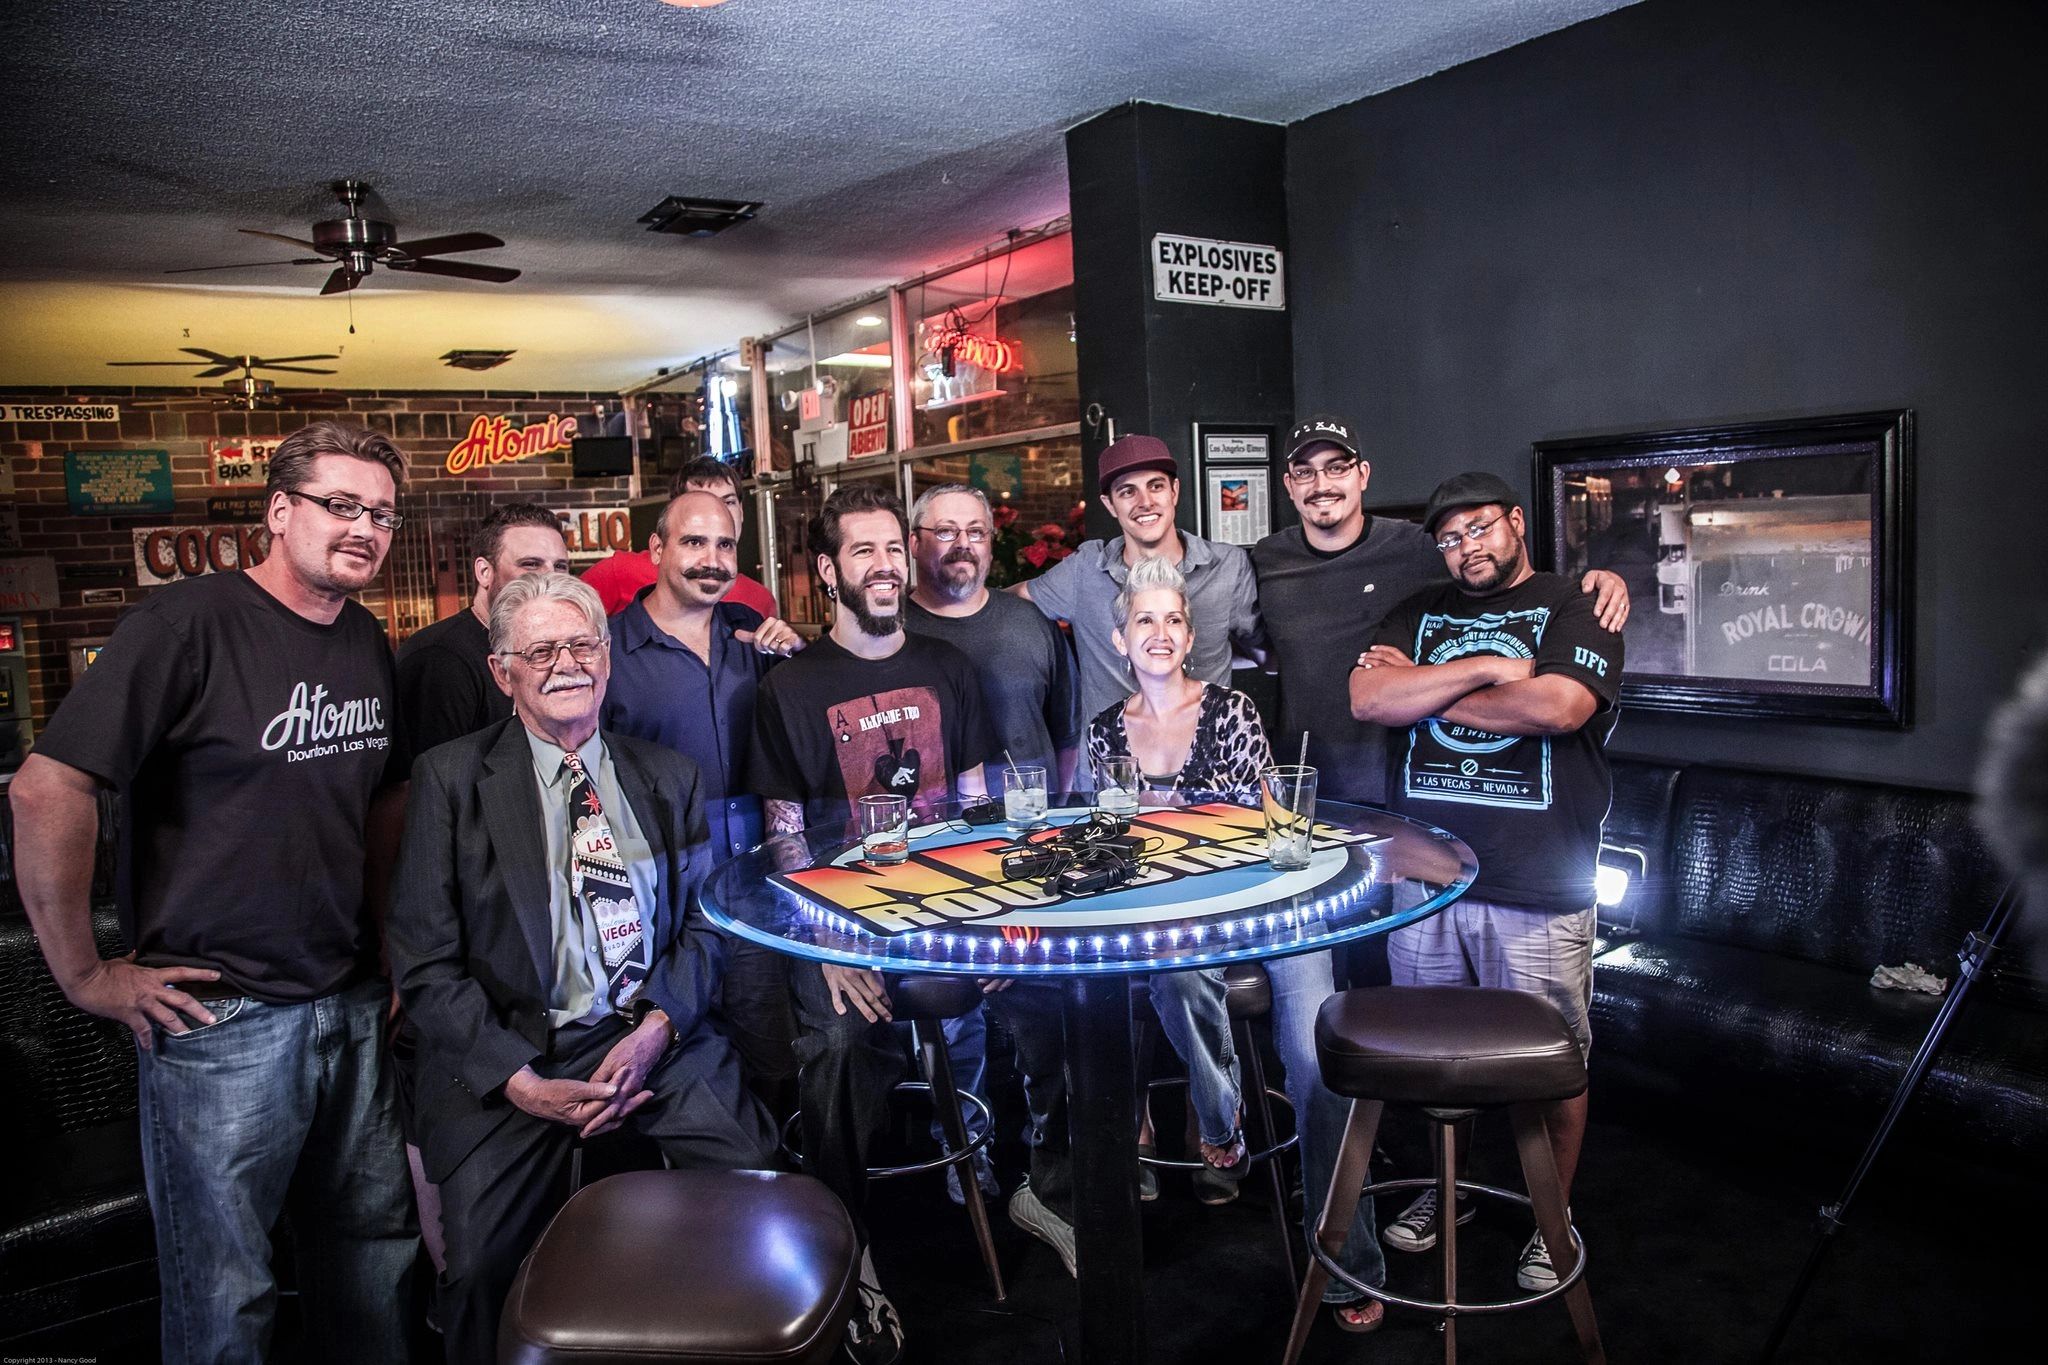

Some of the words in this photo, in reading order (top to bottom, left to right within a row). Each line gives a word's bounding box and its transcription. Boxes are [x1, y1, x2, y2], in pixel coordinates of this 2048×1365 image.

[1159, 241, 1277, 275] EXPLOSIVES
[1168, 270, 1271, 301] KEEP-OFF
[12, 406, 114, 420] TRESPASSING
[853, 393, 886, 426] OPEN
[446, 413, 577, 475] Atomic
[850, 426, 887, 455] ABIERTO
[1209, 444, 1221, 453] Los
[1221, 443, 1245, 454] Angeles
[1246, 444, 1265, 453] Times
[218, 464, 252, 479] BAR
[1718, 581, 1770, 597] Drink
[1720, 604, 1794, 646] ROYAL
[1458, 631, 1488, 647] FIGHTNG
[1573, 645, 1608, 678] UFC
[1768, 655, 1828, 673] COLA
[261, 681, 385, 751] Atomic
[836, 709, 849, 729] A
[287, 744, 339, 763] Downtown
[343, 740, 365, 752] Las
[366, 737, 390, 750] Vegas
[1423, 776, 1438, 787] LAS
[1483, 782, 1519, 794] NEVADA
[587, 837, 612, 853] LAS
[602, 919, 642, 942] VEGAS
[604, 941, 626, 953] EVADA
